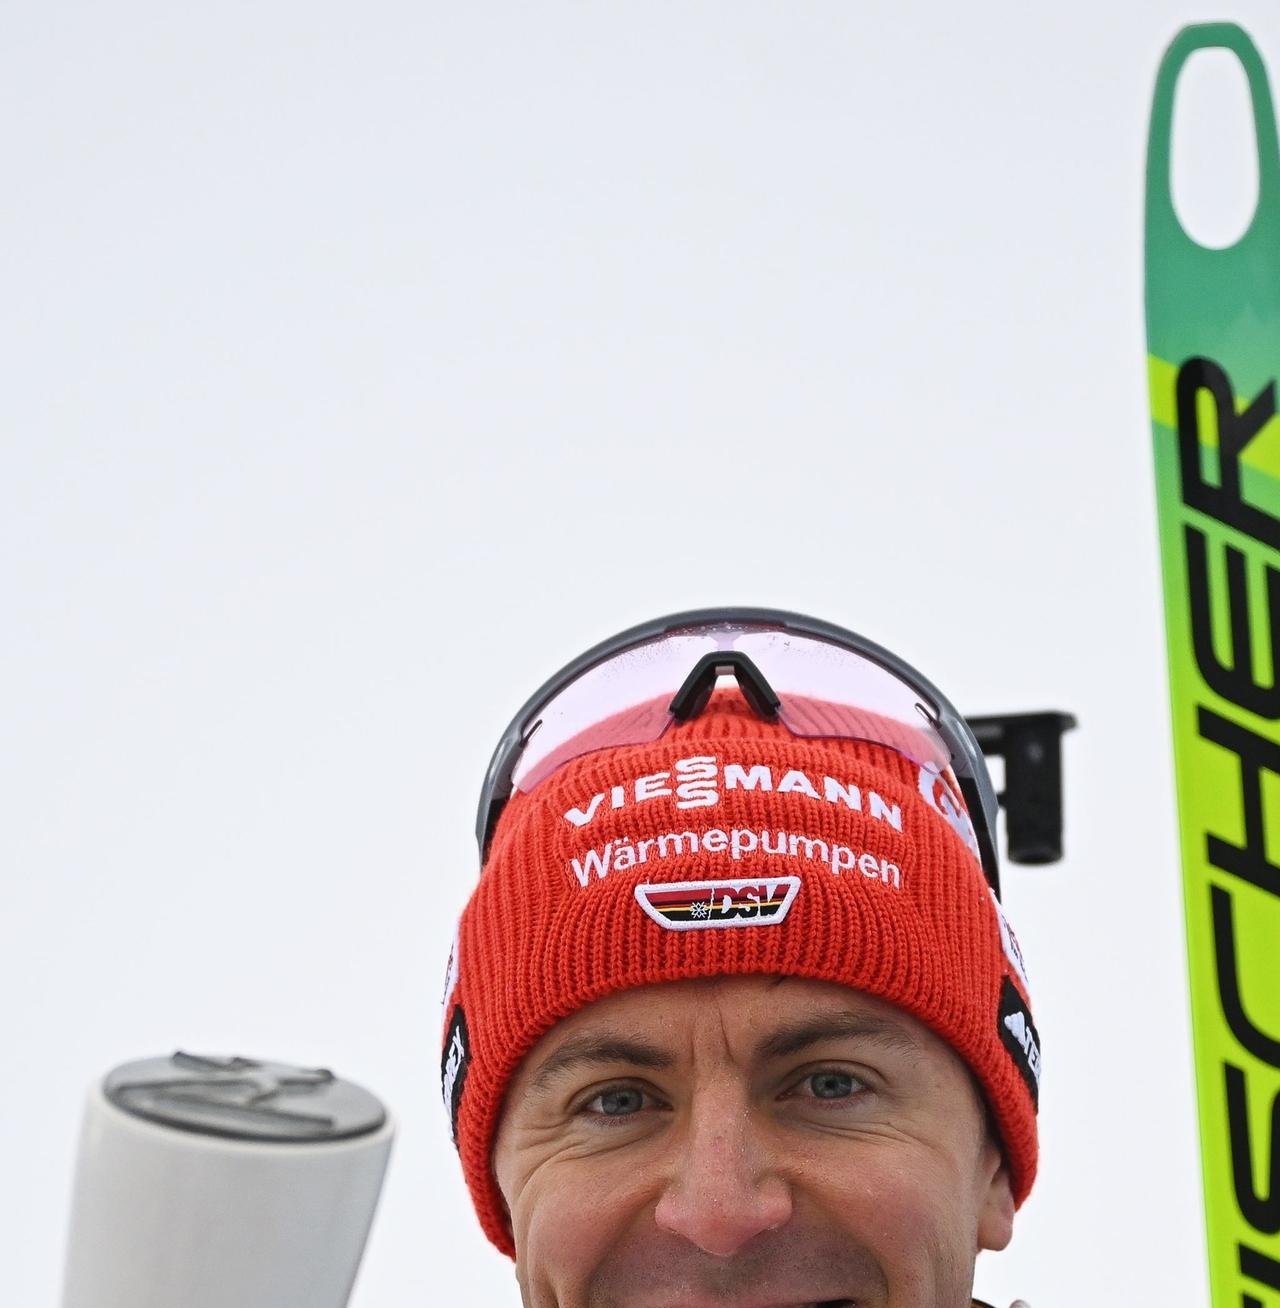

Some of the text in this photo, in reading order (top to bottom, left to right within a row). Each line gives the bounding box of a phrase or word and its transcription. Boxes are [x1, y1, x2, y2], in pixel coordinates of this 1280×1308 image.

[564, 756, 903, 832] VIESSMANN
[571, 828, 901, 889] Wärmepumpen
[712, 886, 791, 920] DSV
